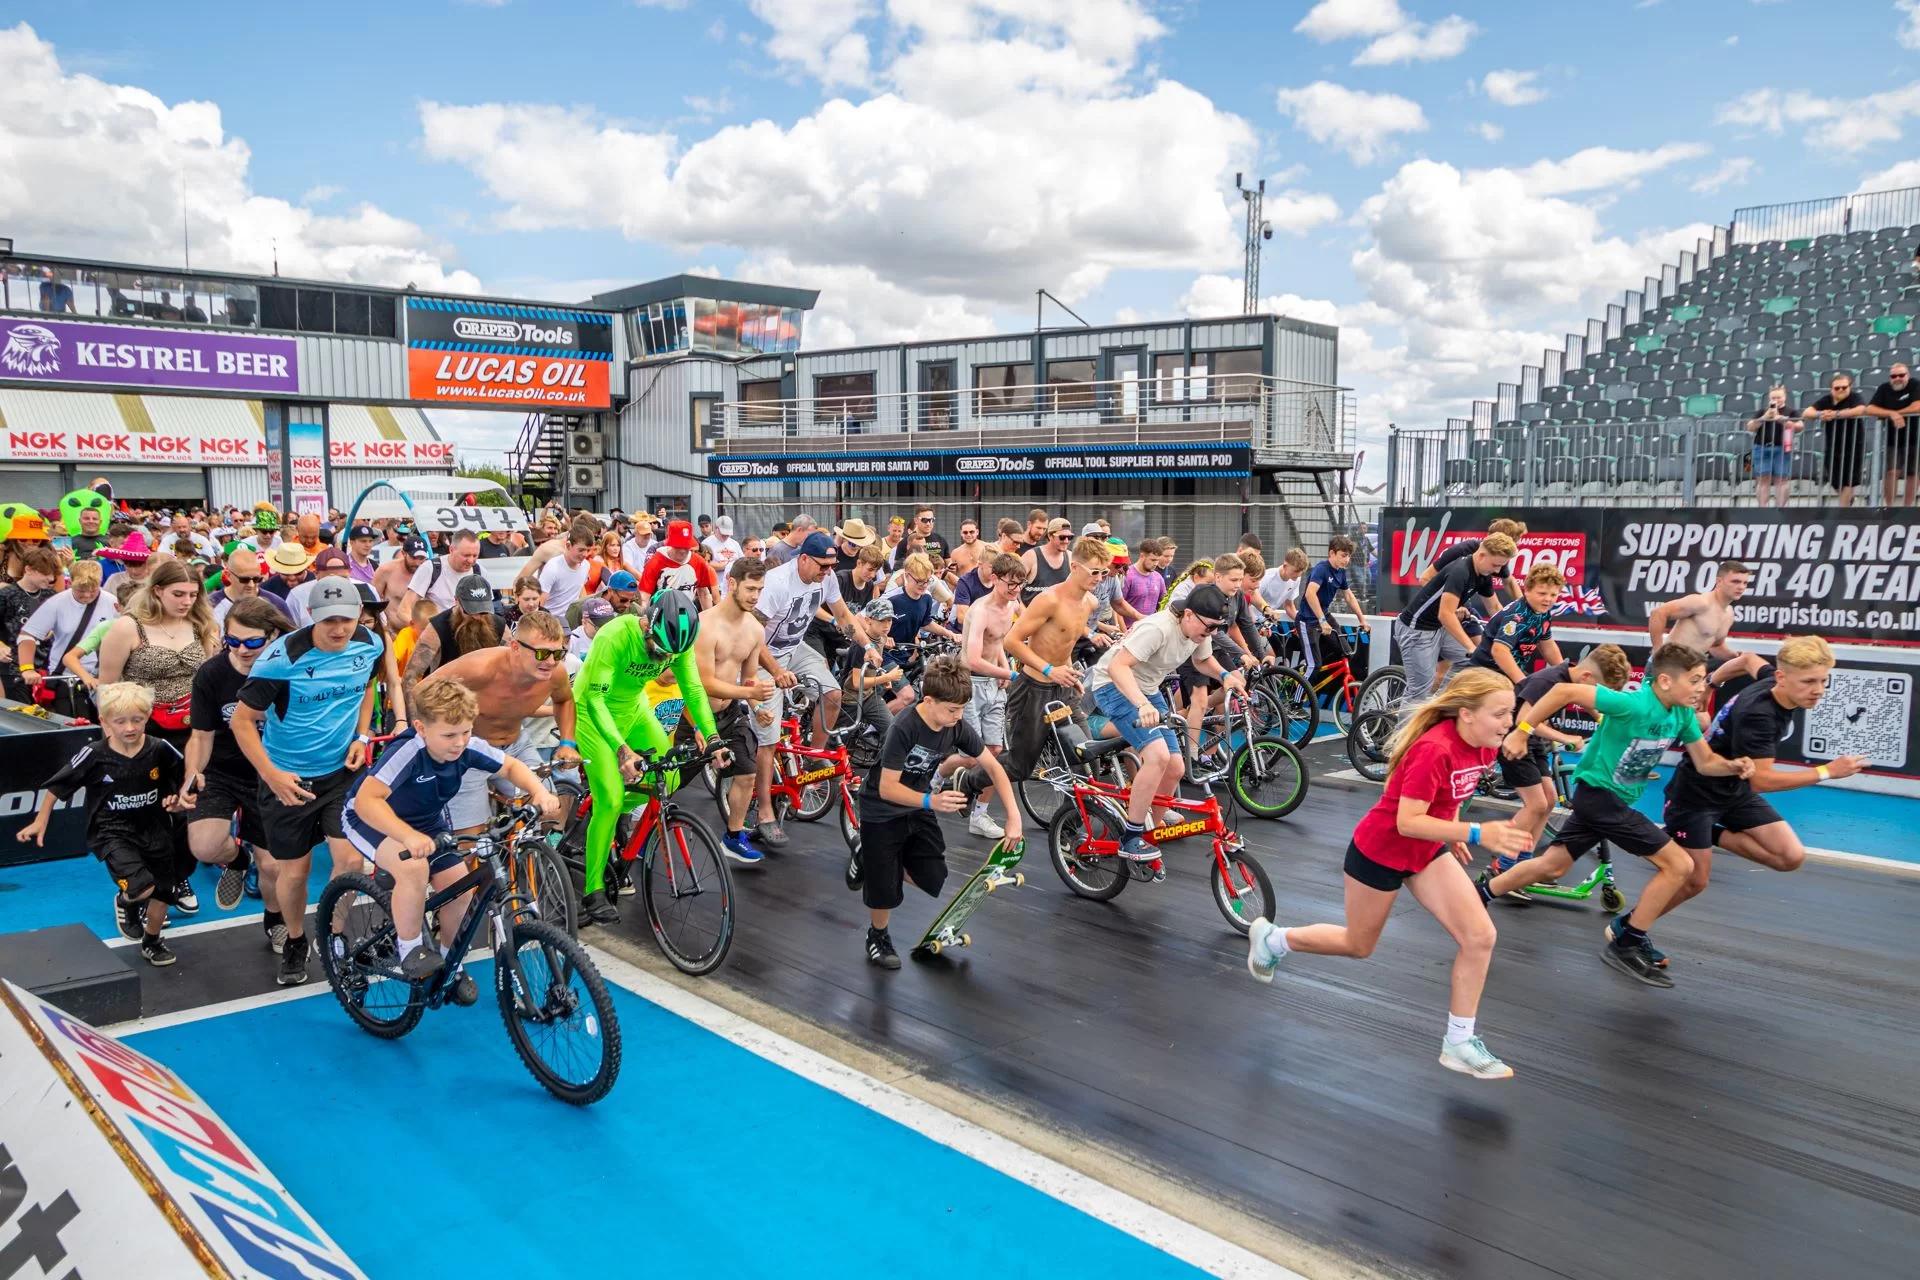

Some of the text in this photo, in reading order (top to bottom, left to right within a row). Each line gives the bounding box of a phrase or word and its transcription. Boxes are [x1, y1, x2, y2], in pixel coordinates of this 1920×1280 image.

[460, 321, 573, 344] DRAPER Tools
[76, 341, 290, 378] KESTREL BEER
[435, 355, 587, 388] LUCAS OIL
[436, 385, 586, 402] www.LucasOil.co.uk
[9, 431, 67, 449] NGK
[76, 433, 130, 451] NGK
[140, 436, 191, 453] NGK
[200, 437, 248, 454] NGK
[330, 441, 356, 457] GK
[364, 442, 406, 458] NGK
[413, 443, 454, 458] NGK
[293, 459, 321, 468] NGK
[721, 463, 779, 475] DRAPER Tools
[786, 461, 929, 473] OFFICIAL TOOL SUPPLIER FOR SANTA POD
[960, 457, 1034, 471] DRAPER Tools
[1045, 454, 1232, 468] OFFICIAL TOOL SUPPLIER FOR SANTA POD
[294, 475, 322, 484] NGK
[1543, 537, 1580, 547] PISTONS
[1618, 523, 1825, 560] SUPPORTING
[1627, 559, 1691, 593] FOR
[1695, 560, 1782, 597] OER
[1785, 562, 1836, 598] 40
[796, 766, 836, 785] CHOPPER
[107, 800, 146, 811] Viewer
[114, 793, 147, 803] Team
[1152, 820, 1206, 841] CHOPPER
